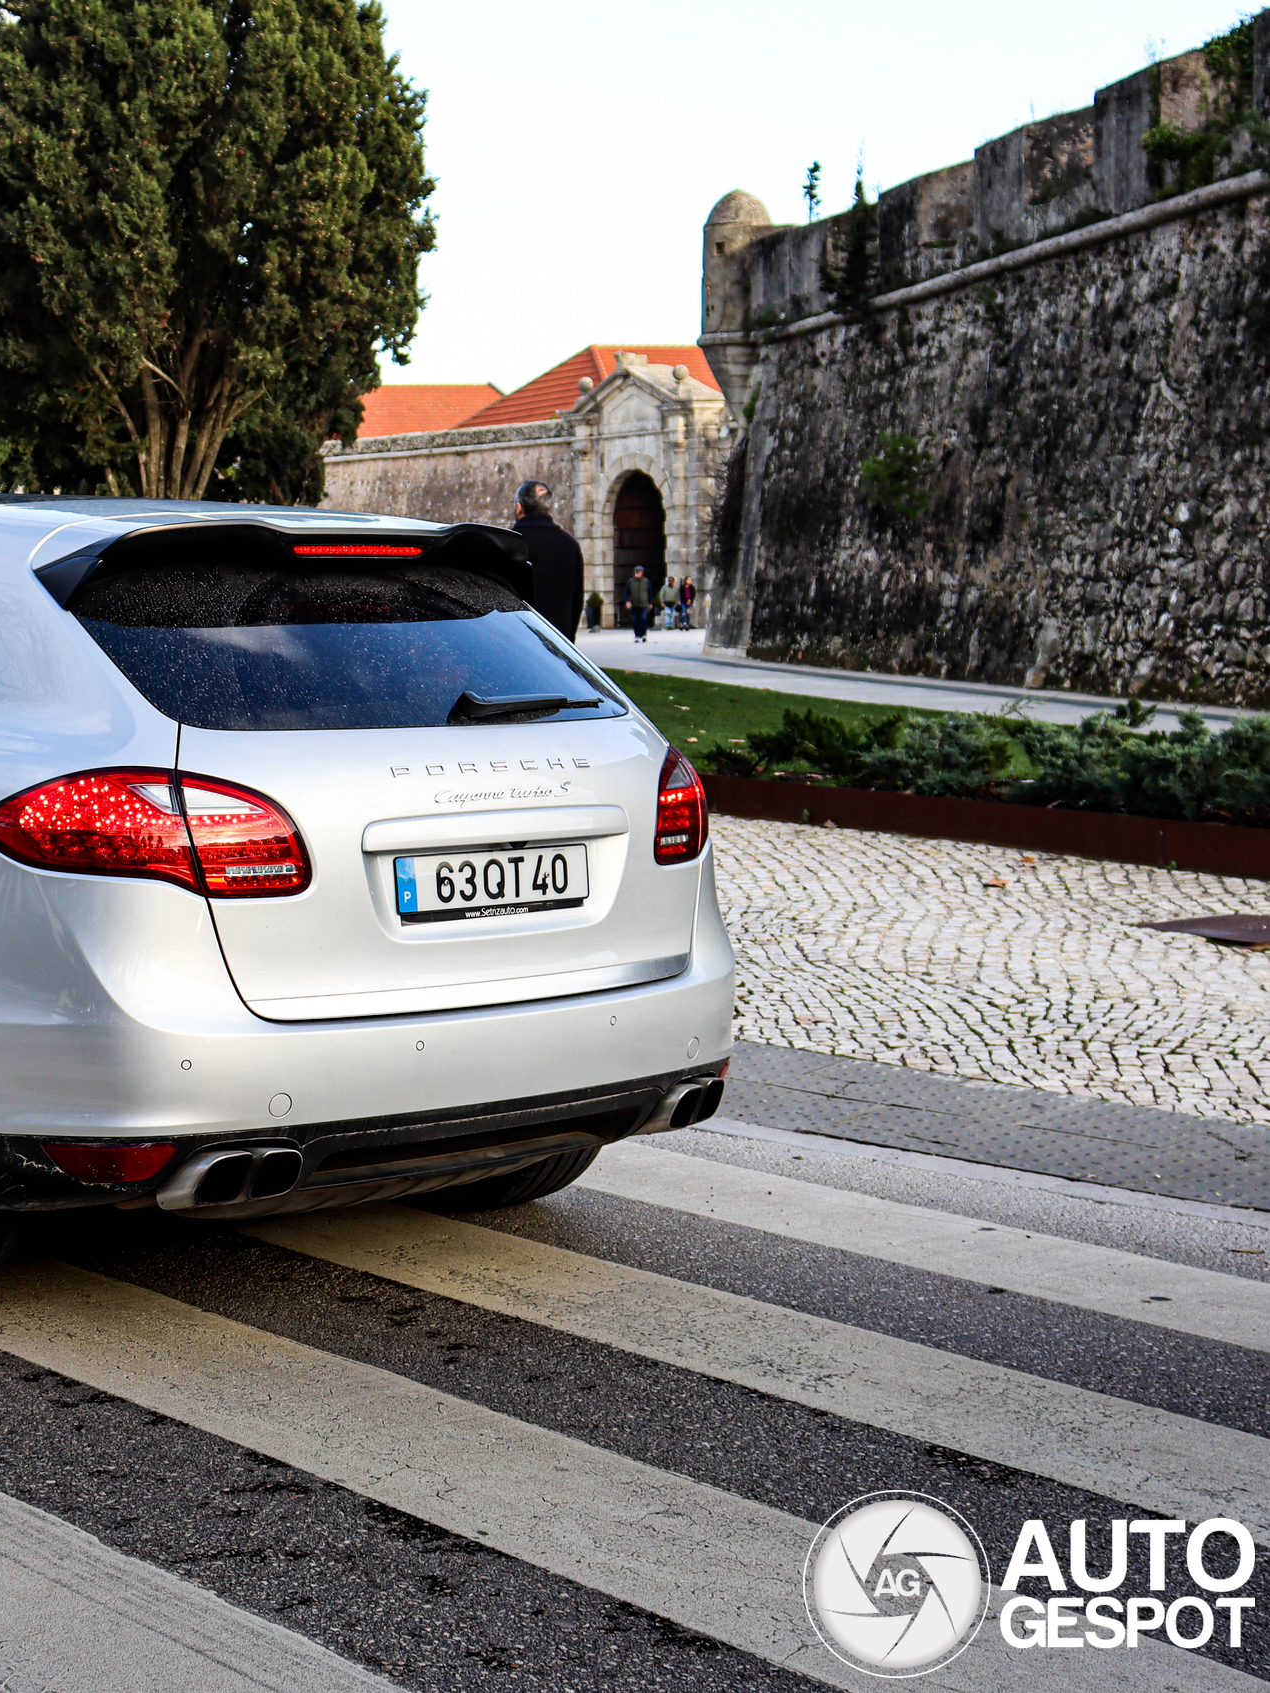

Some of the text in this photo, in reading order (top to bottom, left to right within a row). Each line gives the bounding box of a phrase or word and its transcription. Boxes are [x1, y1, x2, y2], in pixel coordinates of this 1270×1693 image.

[390, 757, 591, 779] PORSCHE
[433, 789, 505, 809] Cayenne
[553, 780, 572, 798] S
